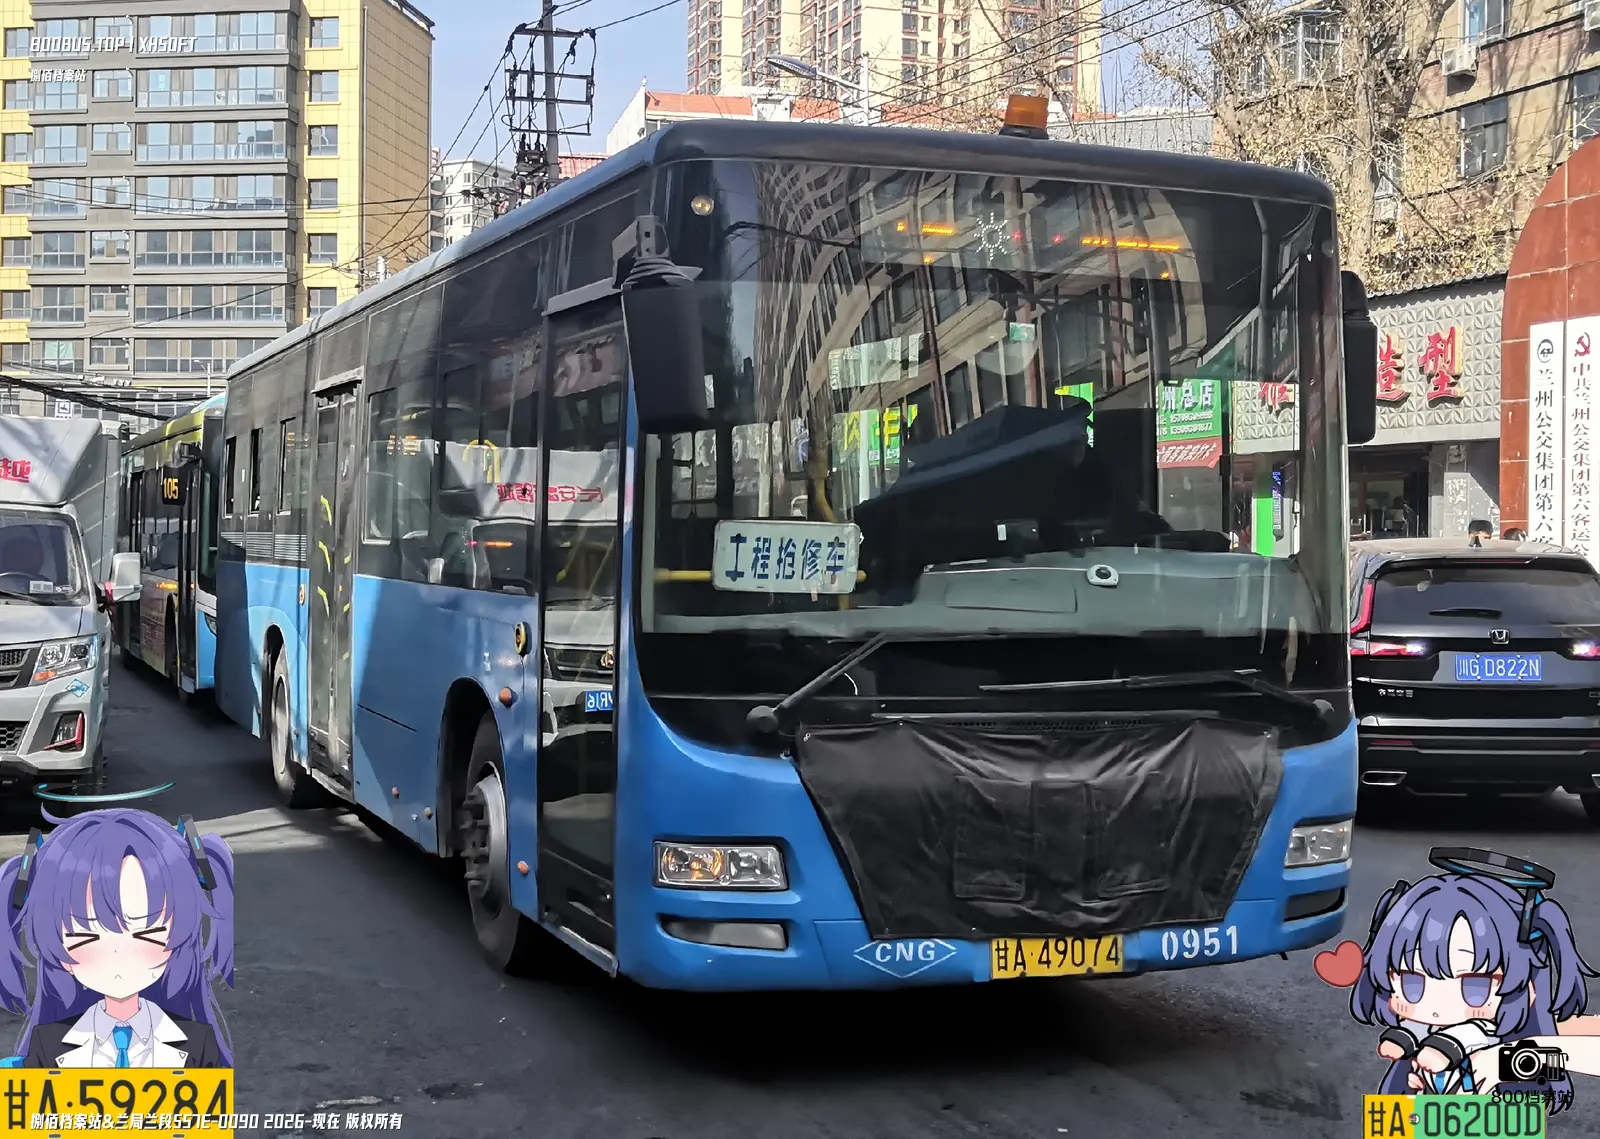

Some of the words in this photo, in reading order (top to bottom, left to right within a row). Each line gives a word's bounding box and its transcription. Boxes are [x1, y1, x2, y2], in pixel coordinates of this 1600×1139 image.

[163, 477, 179, 499] 105
[725, 533, 846, 584] 工程抢修车
[874, 941, 936, 963] CNG
[1161, 926, 1239, 961] 0951
